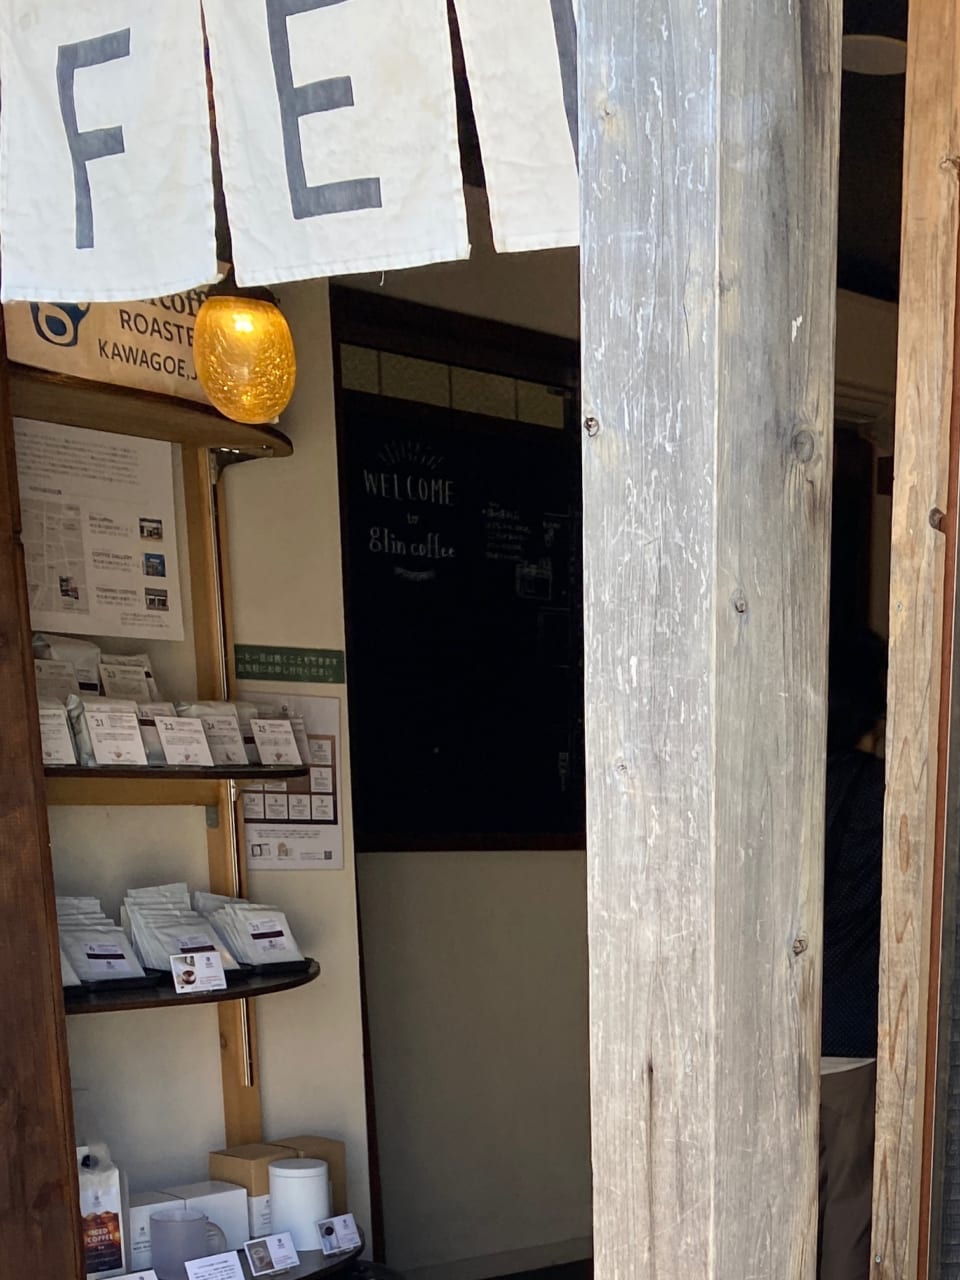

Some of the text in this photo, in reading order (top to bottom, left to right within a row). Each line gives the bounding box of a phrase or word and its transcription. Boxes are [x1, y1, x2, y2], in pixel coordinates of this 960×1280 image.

[119, 309, 195, 347] ROASTE
[363, 469, 455, 506] WELCOME
[368, 526, 455, 559] glin coffee
